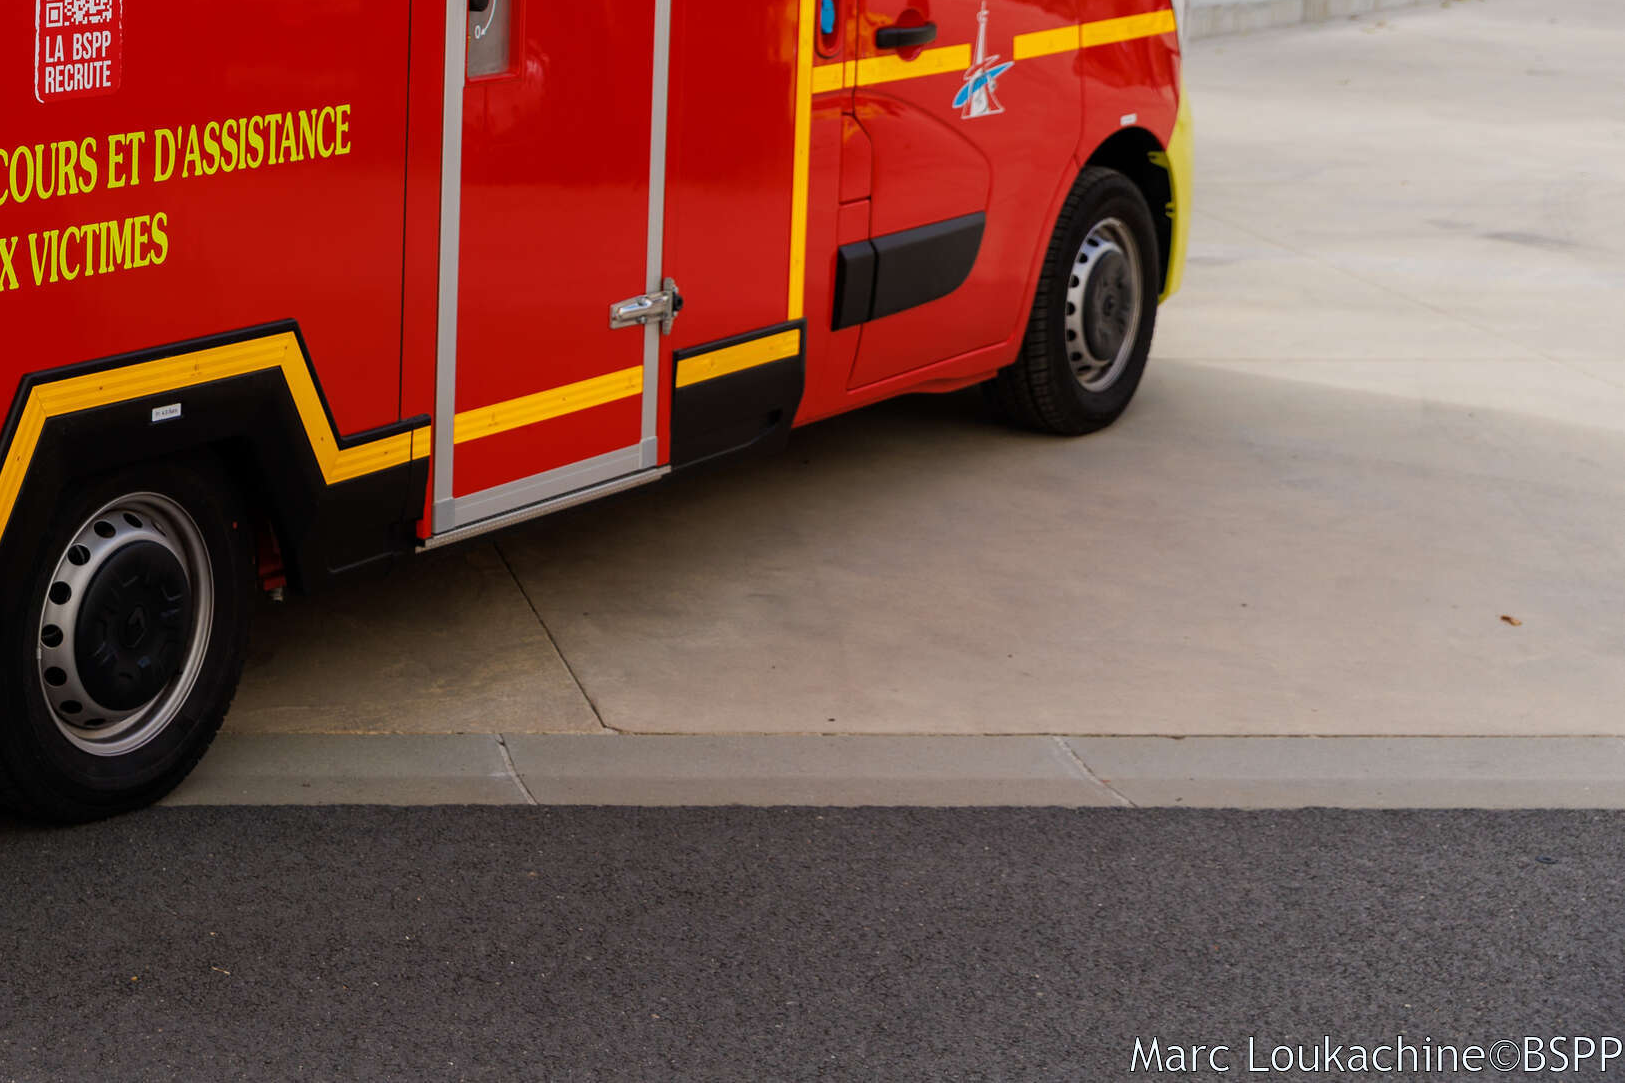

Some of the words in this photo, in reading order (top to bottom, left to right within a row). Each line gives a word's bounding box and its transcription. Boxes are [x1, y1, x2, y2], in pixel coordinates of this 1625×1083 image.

[45, 34, 65, 63] LA
[72, 30, 112, 61] BSPP
[45, 59, 112, 94] RECRUTE
[107, 131, 146, 189] ET
[153, 104, 351, 182] D'ASSISTANCE
[27, 211, 169, 286] VICTIMES
